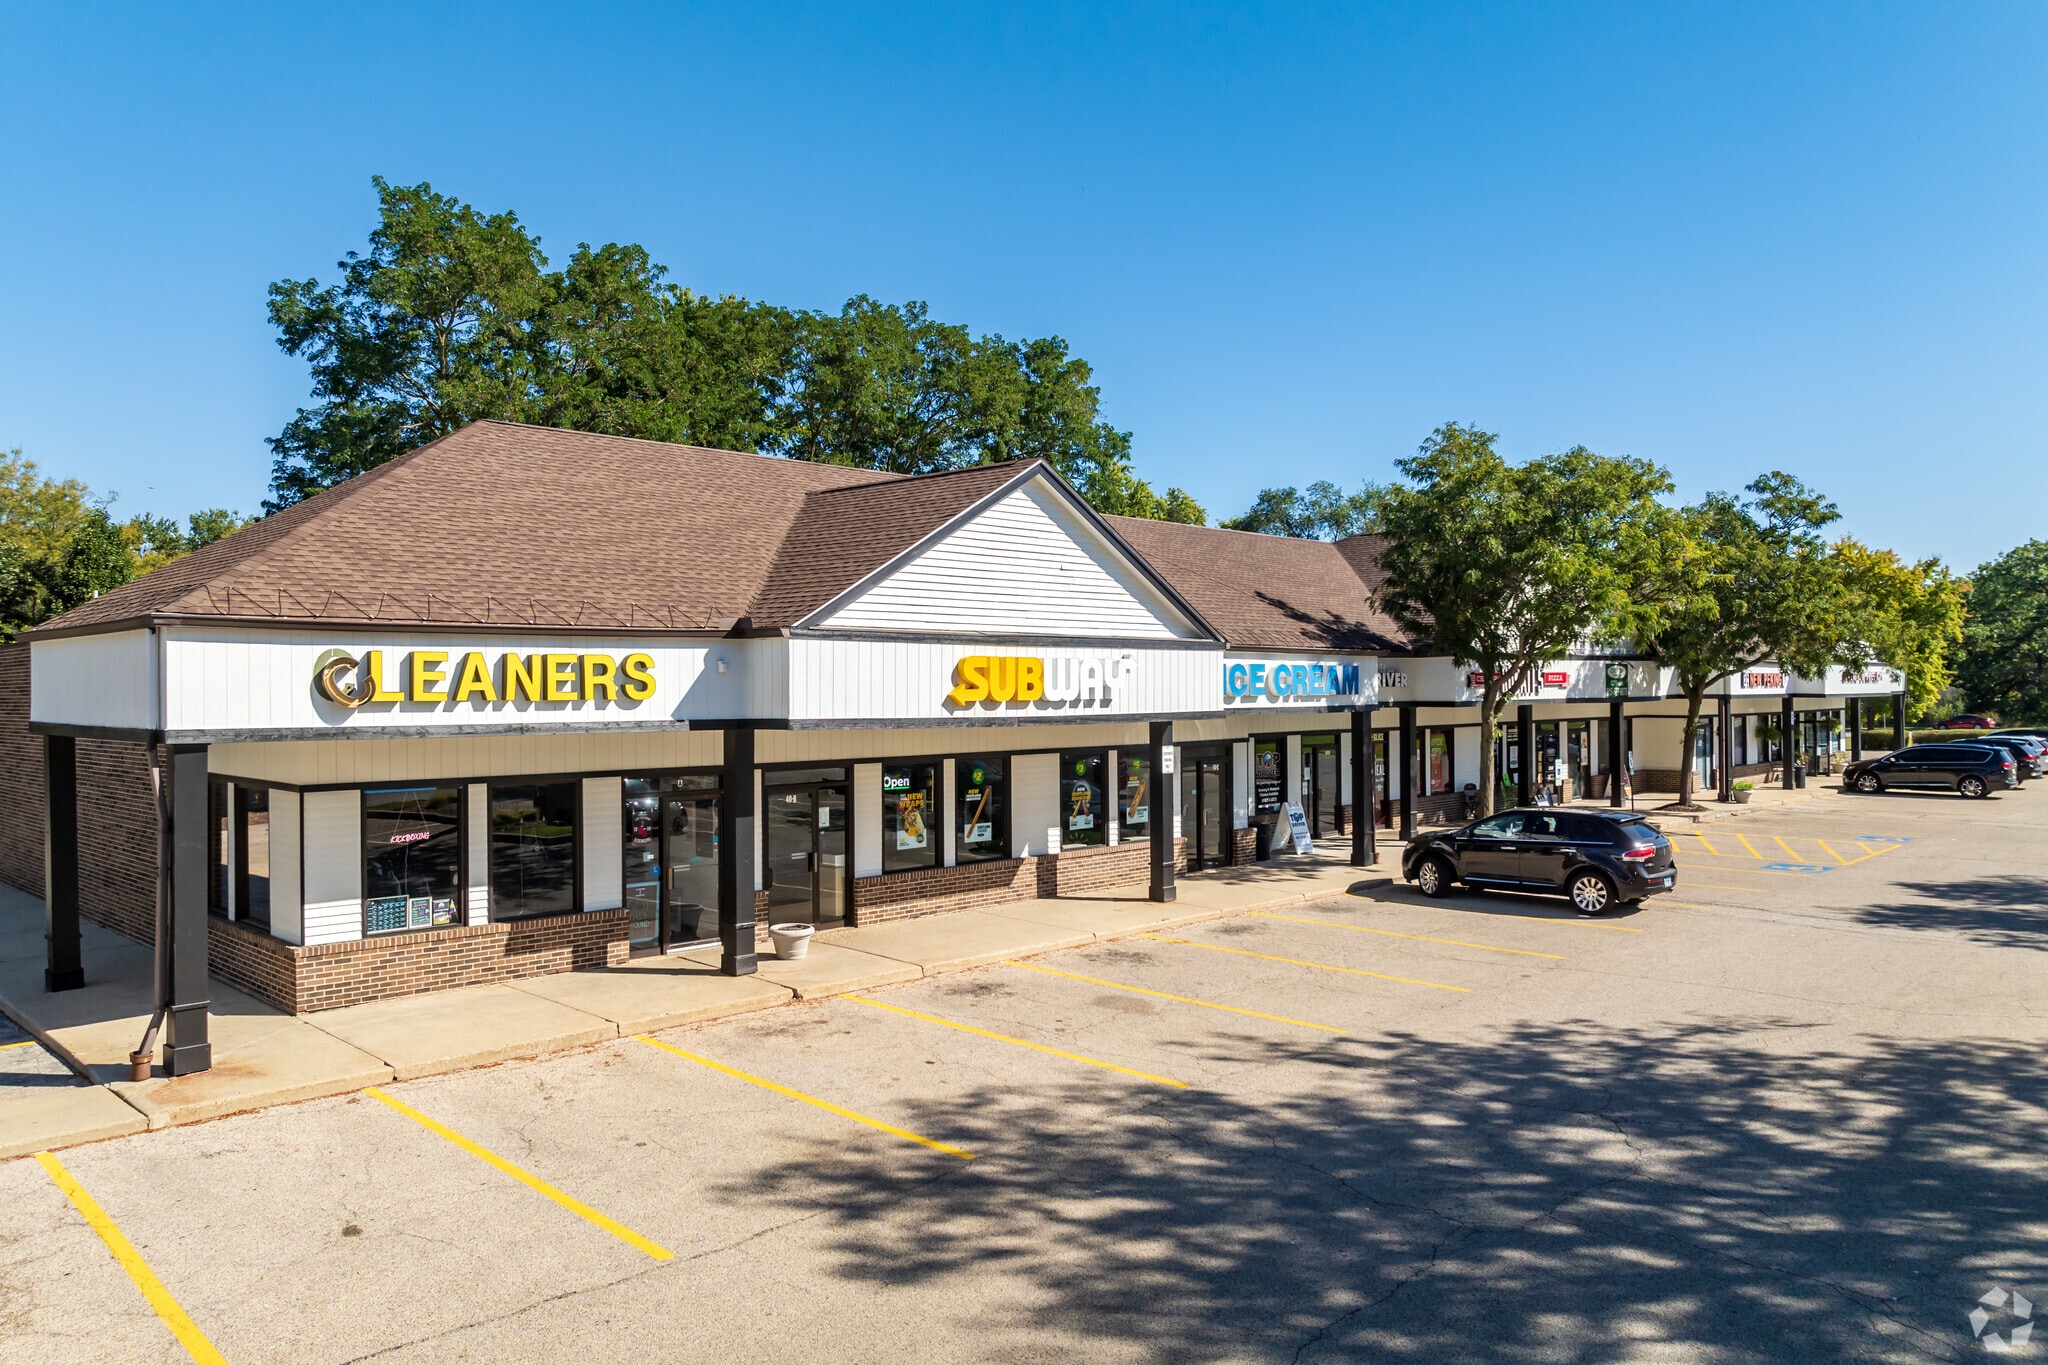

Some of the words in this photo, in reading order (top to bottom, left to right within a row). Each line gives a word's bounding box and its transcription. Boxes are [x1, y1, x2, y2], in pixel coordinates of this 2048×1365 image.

[314, 648, 656, 708] CLEANERS
[948, 654, 1136, 707] SUBWAY
[1271, 663, 1359, 697] CREAM
[1548, 674, 1563, 682] PIZZA
[1750, 673, 1762, 687] NEW
[1764, 673, 1783, 687] PEKING
[1256, 750, 1280, 769] TOP
[973, 771, 982, 781] $2
[884, 776, 909, 789] Open
[907, 792, 923, 800] NEW
[899, 799, 925, 807] WRAPS
[1289, 812, 1304, 822] TOP
[390, 831, 430, 843] KICKBOXING
